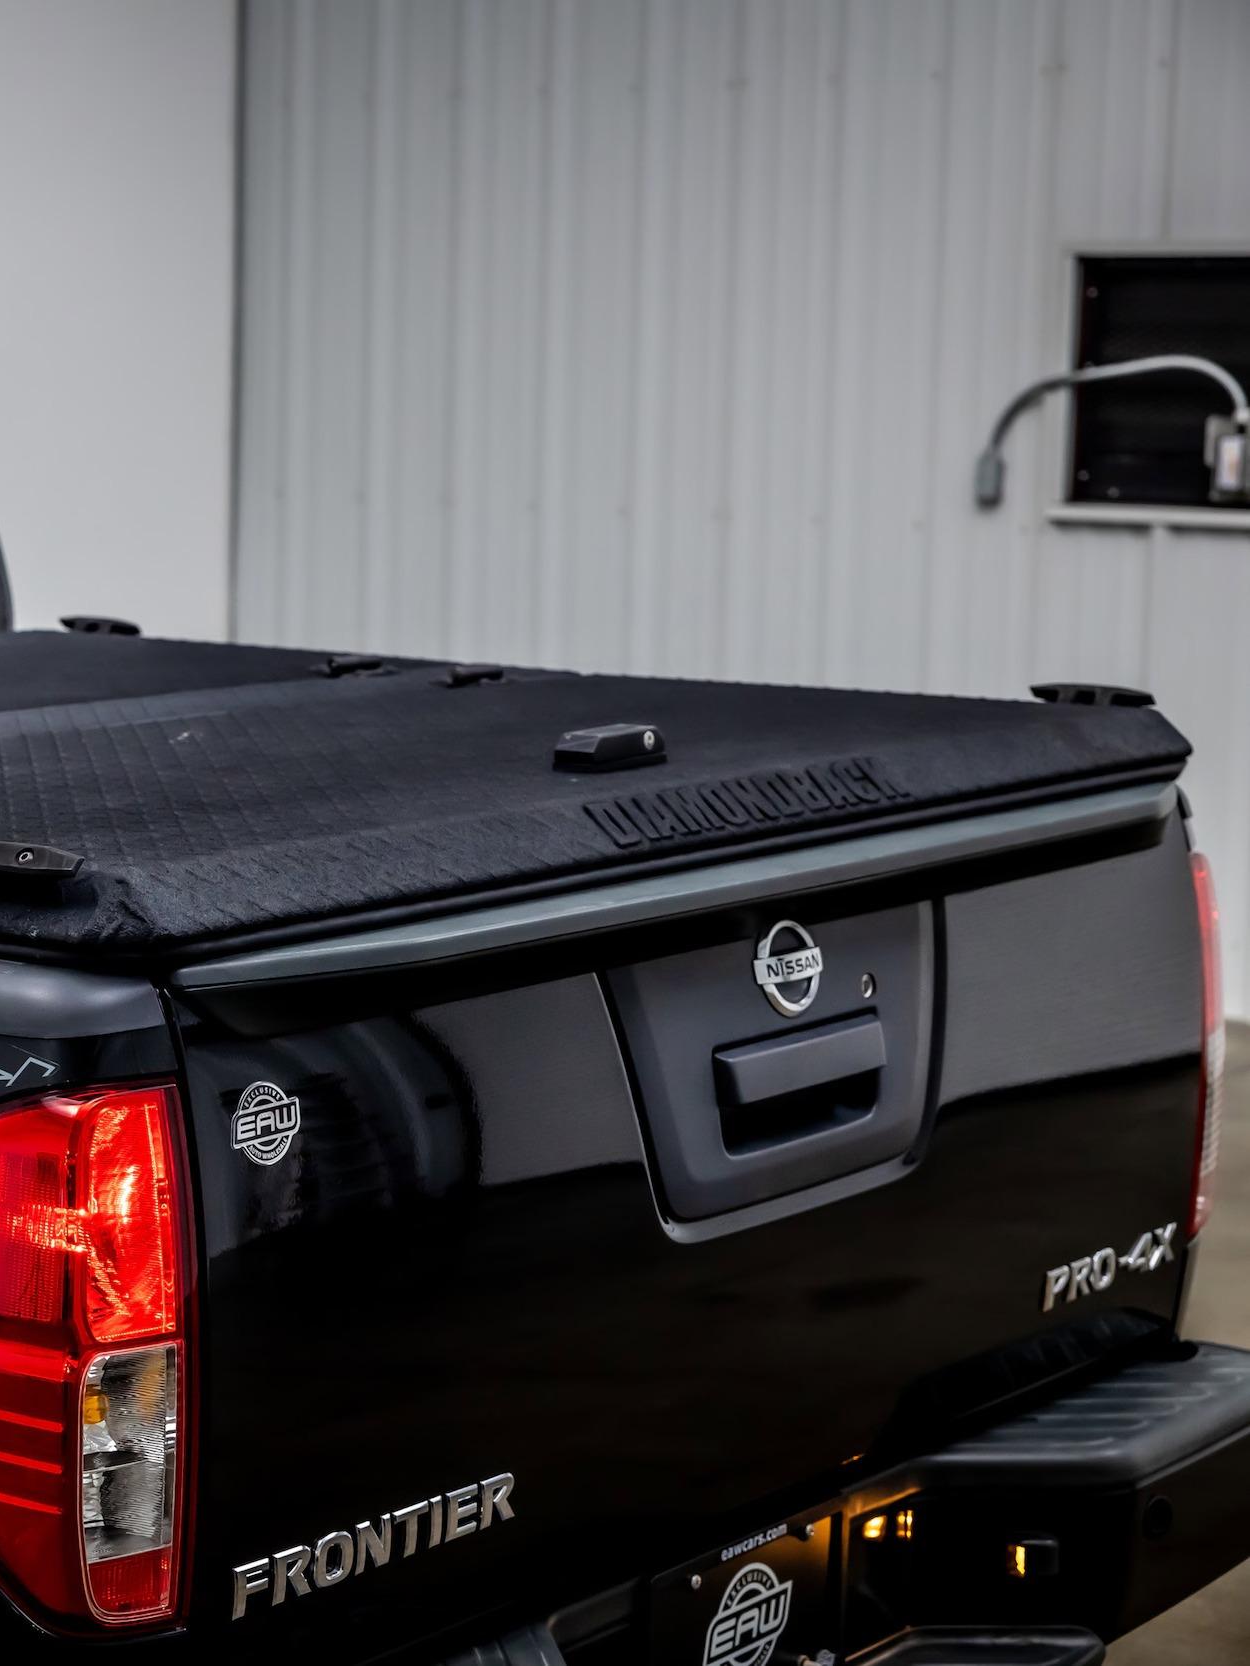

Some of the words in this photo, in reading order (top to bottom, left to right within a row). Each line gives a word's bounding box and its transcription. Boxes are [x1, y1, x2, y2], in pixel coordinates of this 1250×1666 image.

[582, 756, 912, 851] DIAMONDBACK
[766, 952, 821, 979] NISSAN
[236, 1105, 296, 1141] EAW
[1042, 1221, 1178, 1313] PRO-4X
[231, 1472, 516, 1621] FRONTIER
[721, 1523, 788, 1562] eawcars.com
[710, 1594, 786, 1658] EAW
